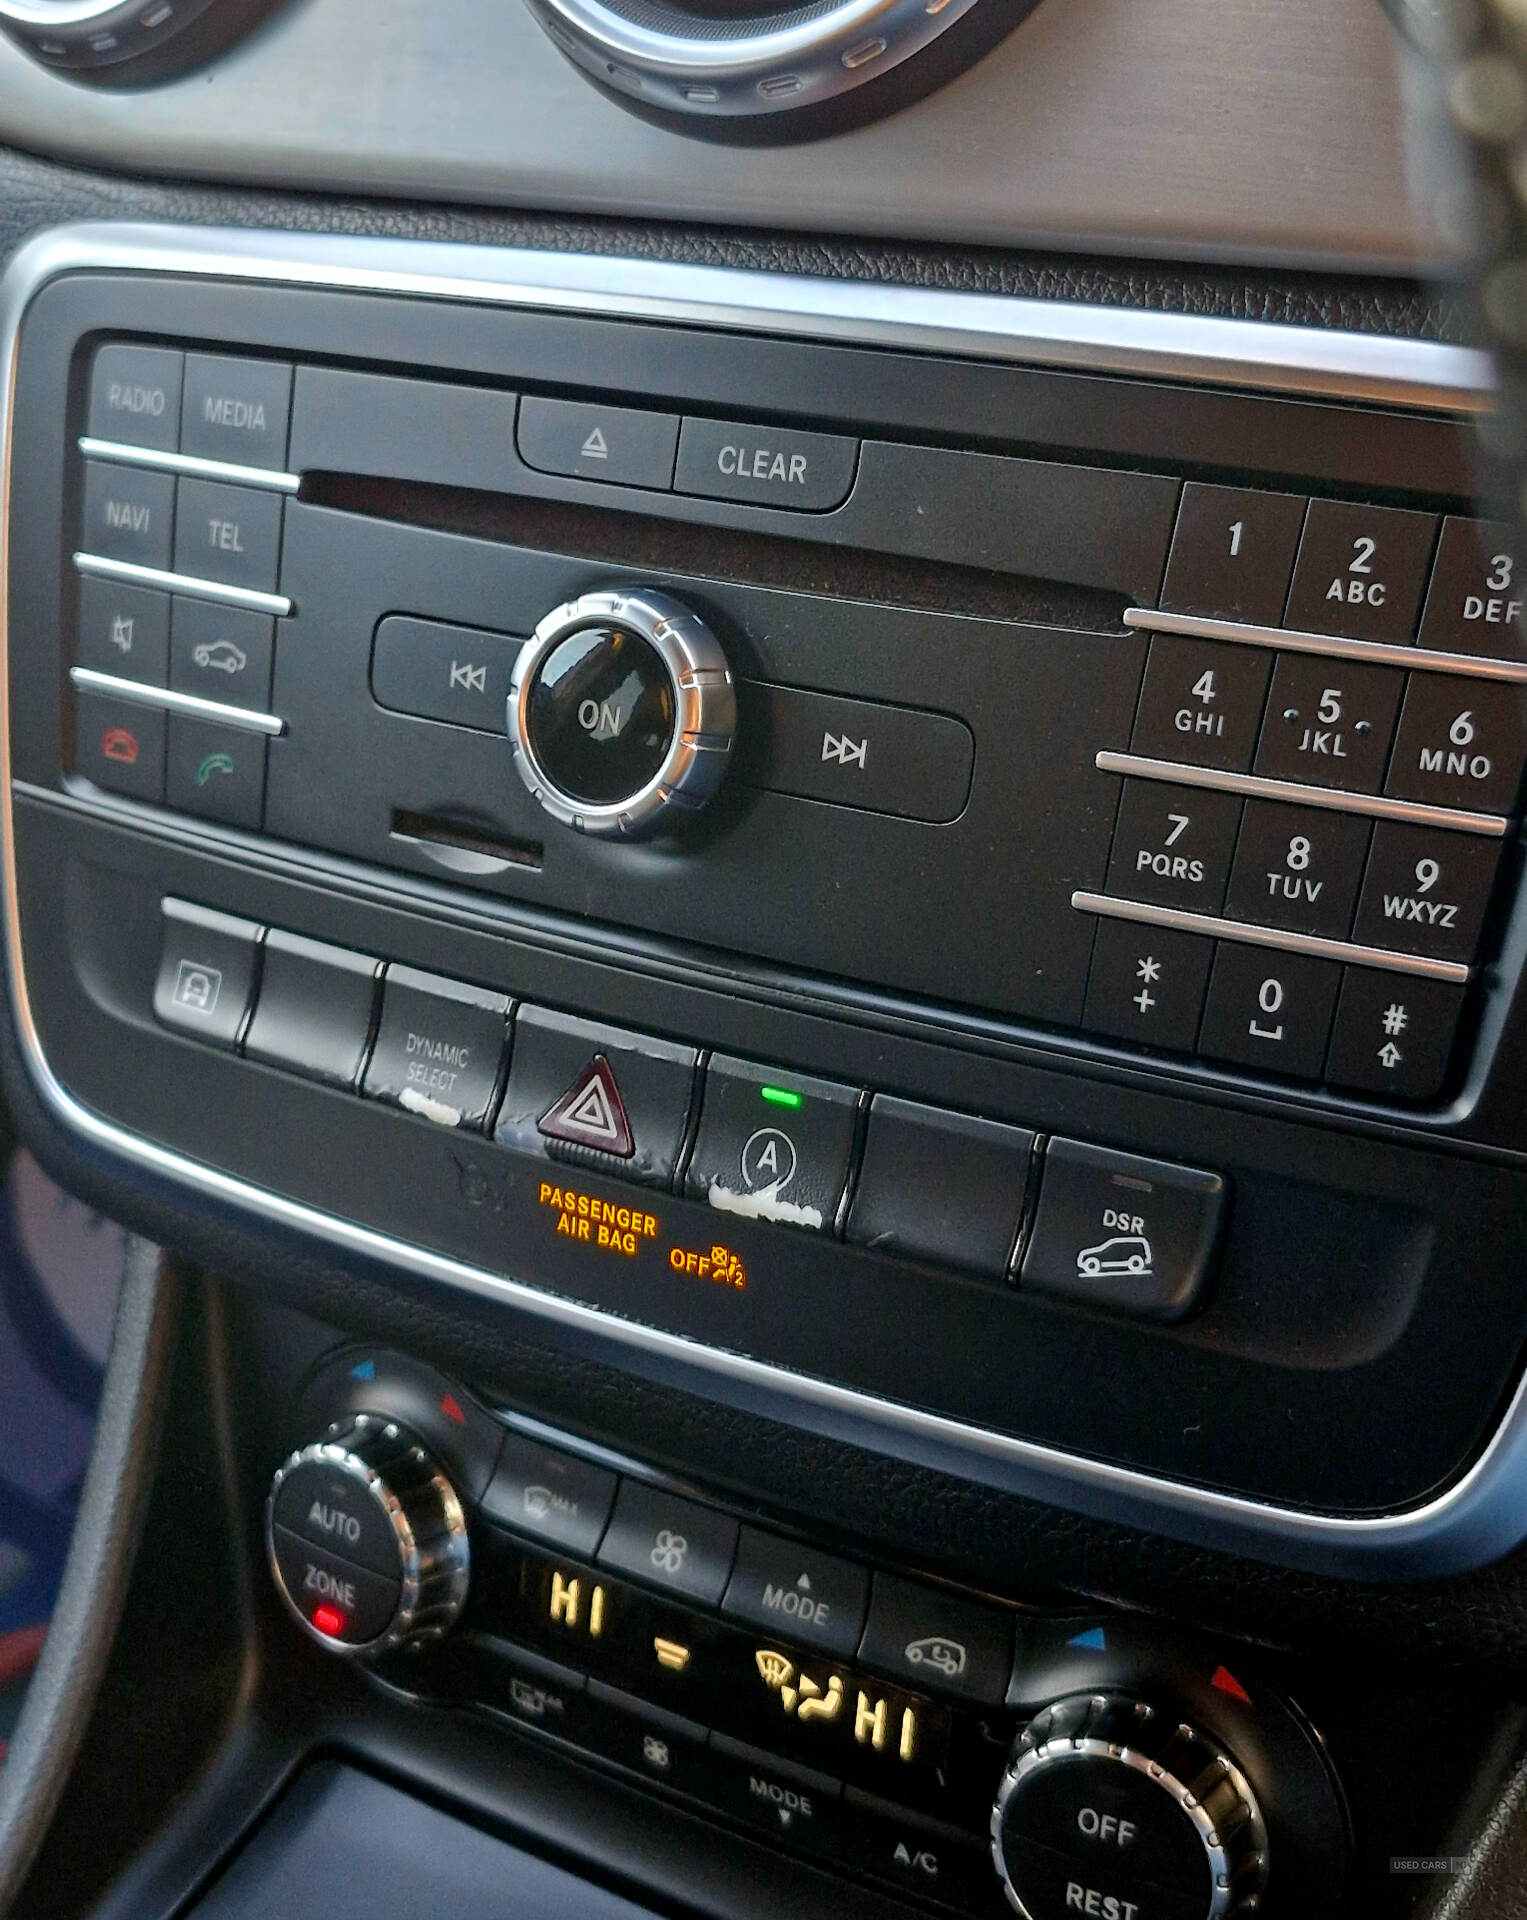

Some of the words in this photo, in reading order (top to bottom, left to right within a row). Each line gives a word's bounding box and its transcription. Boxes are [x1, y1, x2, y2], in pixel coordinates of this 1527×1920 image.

[107, 384, 166, 417] RADIO
[205, 397, 266, 432] MEDIA
[717, 446, 807, 484] CLEAR
[106, 501, 150, 535] NAVI
[208, 518, 244, 553] TEL
[1228, 521, 1244, 556] 1
[1348, 536, 1377, 574] 2
[1486, 554, 1514, 591] 3
[1326, 577, 1387, 608] ABC
[1463, 595, 1523, 625] DEF
[1191, 670, 1216, 704] 4
[577, 699, 621, 735] ON
[1174, 708, 1224, 737] GHI
[1316, 688, 1343, 724] 5
[1298, 728, 1348, 758] JKL
[1448, 711, 1475, 747] 6
[1419, 747, 1492, 780] MNO
[1163, 813, 1190, 847] 7
[1136, 850, 1204, 882] PQRS
[1286, 836, 1311, 871] 8
[1266, 872, 1323, 903] TUV
[1414, 858, 1440, 893] 9
[1383, 894, 1459, 929] WXYZ
[1258, 978, 1284, 1013] 0
[406, 1032, 470, 1069] DYNAMIC
[406, 1061, 457, 1092] SELECT
[756, 1140, 778, 1173] A
[539, 1182, 657, 1236] PASSENGER
[1102, 1208, 1145, 1235] DSR
[556, 1213, 590, 1241] AIR
[597, 1225, 636, 1254] BAG
[669, 1248, 710, 1277] OFF
[308, 1501, 361, 1541] AUTO
[303, 1563, 356, 1608] ZONE
[761, 1583, 830, 1627] MODE
[750, 1776, 812, 1816] MODE
[1077, 1808, 1136, 1847] OFF
[893, 1842, 939, 1874] A/C
[1065, 1881, 1139, 1920] REST
